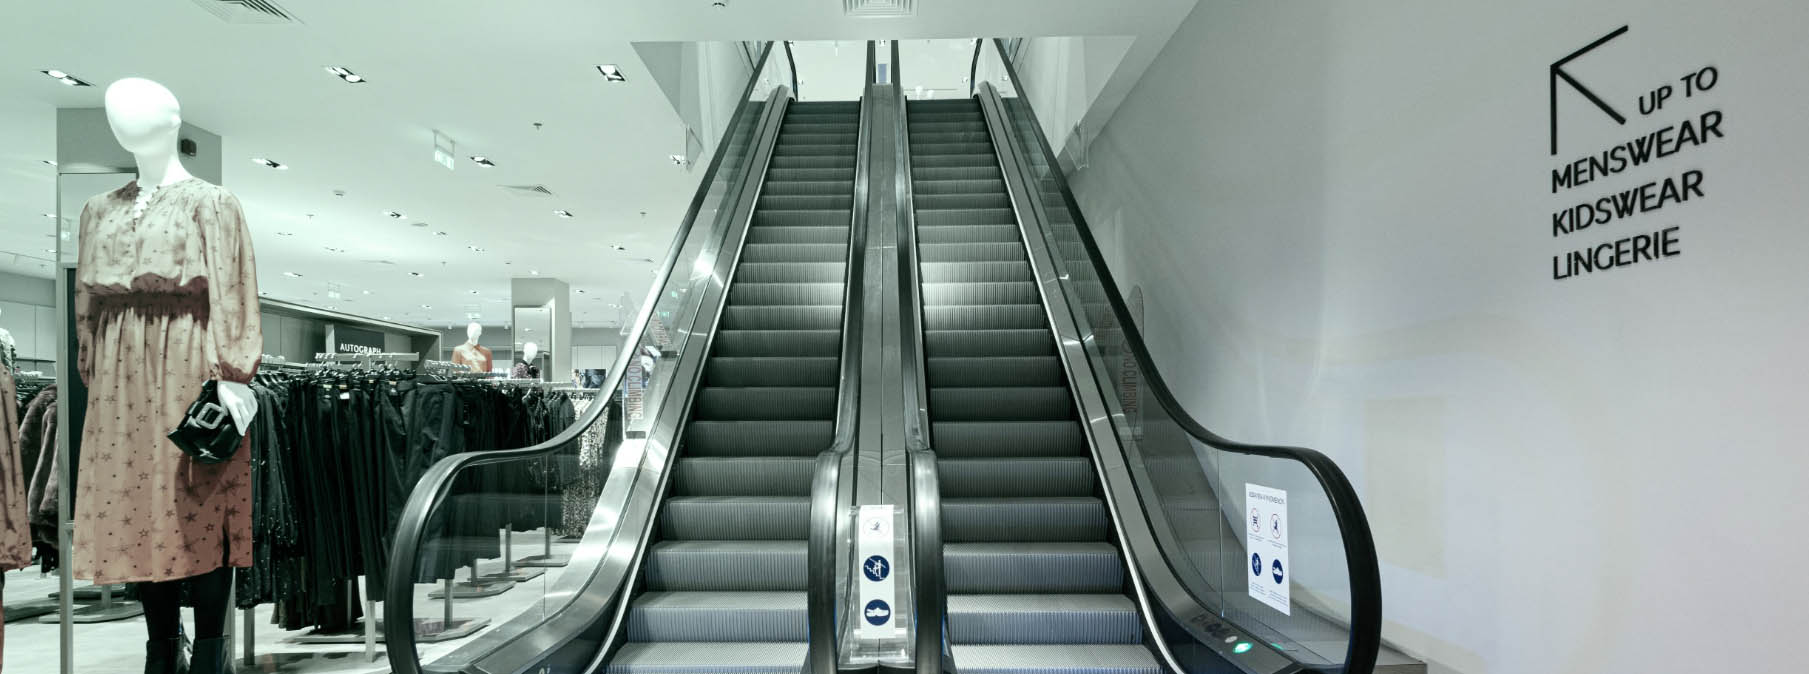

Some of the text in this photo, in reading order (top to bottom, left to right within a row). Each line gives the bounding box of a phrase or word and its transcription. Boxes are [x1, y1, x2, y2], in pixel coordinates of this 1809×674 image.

[1638, 66, 1718, 116] UP TO
[1551, 110, 1724, 194] MENSWEAR
[1552, 169, 1704, 237] KIDSWEAR
[1553, 226, 1680, 280] LINGERIE
[340, 343, 381, 354] AUTOGRAPH
[628, 375, 643, 419] CLIMBING
